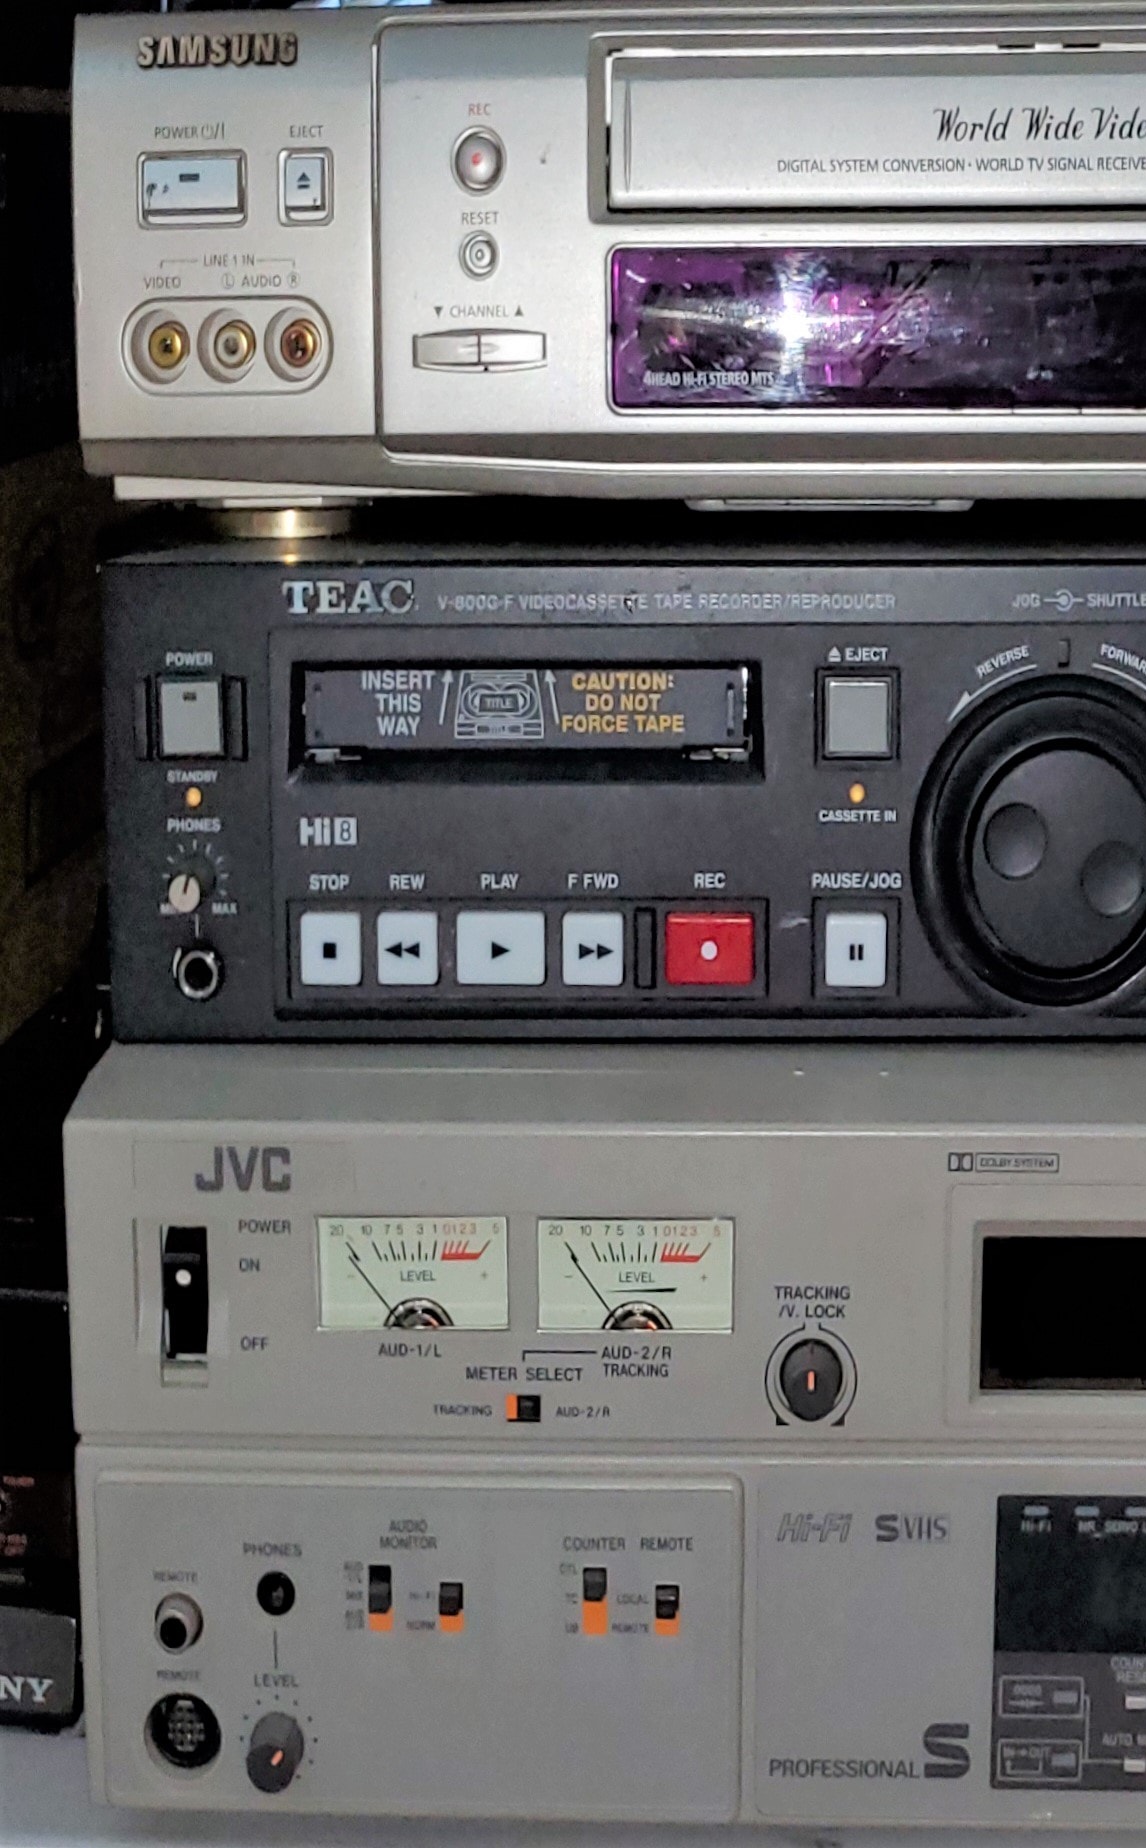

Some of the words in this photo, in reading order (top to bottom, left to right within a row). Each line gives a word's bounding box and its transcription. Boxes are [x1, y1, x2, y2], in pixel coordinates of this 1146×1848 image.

[136, 32, 298, 68] SAMSUNG
[467, 103, 490, 116] REC
[289, 124, 323, 138] EJECT
[933, 106, 1008, 142] World
[1023, 106, 1085, 141] Wide
[154, 125, 199, 139] POWER
[777, 160, 826, 173] DIGITAL
[830, 159, 878, 172] SYSTEM
[883, 158, 965, 172] CONVERSION
[976, 158, 1024, 171] WORLD
[1028, 158, 1044, 171] TV
[1047, 157, 1094, 171] SIGNAL
[461, 211, 499, 225] RESET
[203, 253, 229, 267] LINE
[242, 253, 255, 267] IN
[143, 276, 181, 289] VIDEO
[241, 273, 282, 288] AUDIO
[450, 304, 509, 319] CHANNEL
[643, 371, 681, 386] 4HEAD
[683, 372, 710, 386] HI-FI
[710, 372, 749, 386] STEREO
[752, 372, 774, 385] MTS
[282, 580, 416, 614] TEAC
[654, 594, 692, 609] TAPE
[699, 594, 895, 610] RECORDER/REPRODUCER
[1012, 594, 1040, 607] JOG
[166, 652, 213, 667] POWER
[845, 647, 888, 662] EJECT
[976, 645, 1030, 678] REVERSE
[361, 670, 435, 690] INSERT
[572, 672, 674, 691] CAUTION:
[375, 693, 422, 713] THIS
[586, 694, 613, 711] DO
[620, 693, 661, 711] NOT
[377, 717, 421, 736] WAY
[562, 715, 627, 733] FORCE
[635, 715, 684, 733] TAPE
[167, 771, 218, 784] STANDBY
[819, 810, 881, 822] CASSETTE
[884, 810, 897, 822] IN
[167, 818, 221, 833] PHONES
[300, 818, 357, 846] Hi8
[309, 875, 349, 890] STOP
[390, 875, 425, 890] REW
[481, 874, 519, 890] PLAY
[568, 874, 577, 889] F
[584, 874, 619, 889] FWD
[694, 874, 726, 889] REC
[812, 874, 902, 889] PAUSE/JOG
[195, 1146, 291, 1192] JVC
[238, 1220, 291, 1234] POWER
[239, 1259, 260, 1272] ON
[400, 1271, 436, 1281] LEVEL
[619, 1272, 655, 1283] LEVEL
[775, 1286, 850, 1300] TRACKING
[805, 1305, 845, 1318] LOCK
[240, 1338, 268, 1350] OFF
[379, 1343, 442, 1358] AUD-1/L
[602, 1346, 672, 1361] AUD-2/R
[466, 1367, 518, 1381] METER
[526, 1367, 583, 1381] SELECT
[603, 1363, 669, 1378] TRACKING
[434, 1405, 492, 1417] TRACKING
[556, 1405, 610, 1417] AUD-2/R
[389, 1520, 427, 1533] AUDIO
[777, 1513, 853, 1543] Hi-Fi
[243, 1543, 302, 1557] PHONES
[380, 1536, 437, 1549] MONITOR
[563, 1536, 625, 1550] COUNTER
[640, 1537, 693, 1551] REMOTE
[255, 1674, 298, 1688] LEVEL
[769, 1759, 919, 1778] PROFESSIONAL
